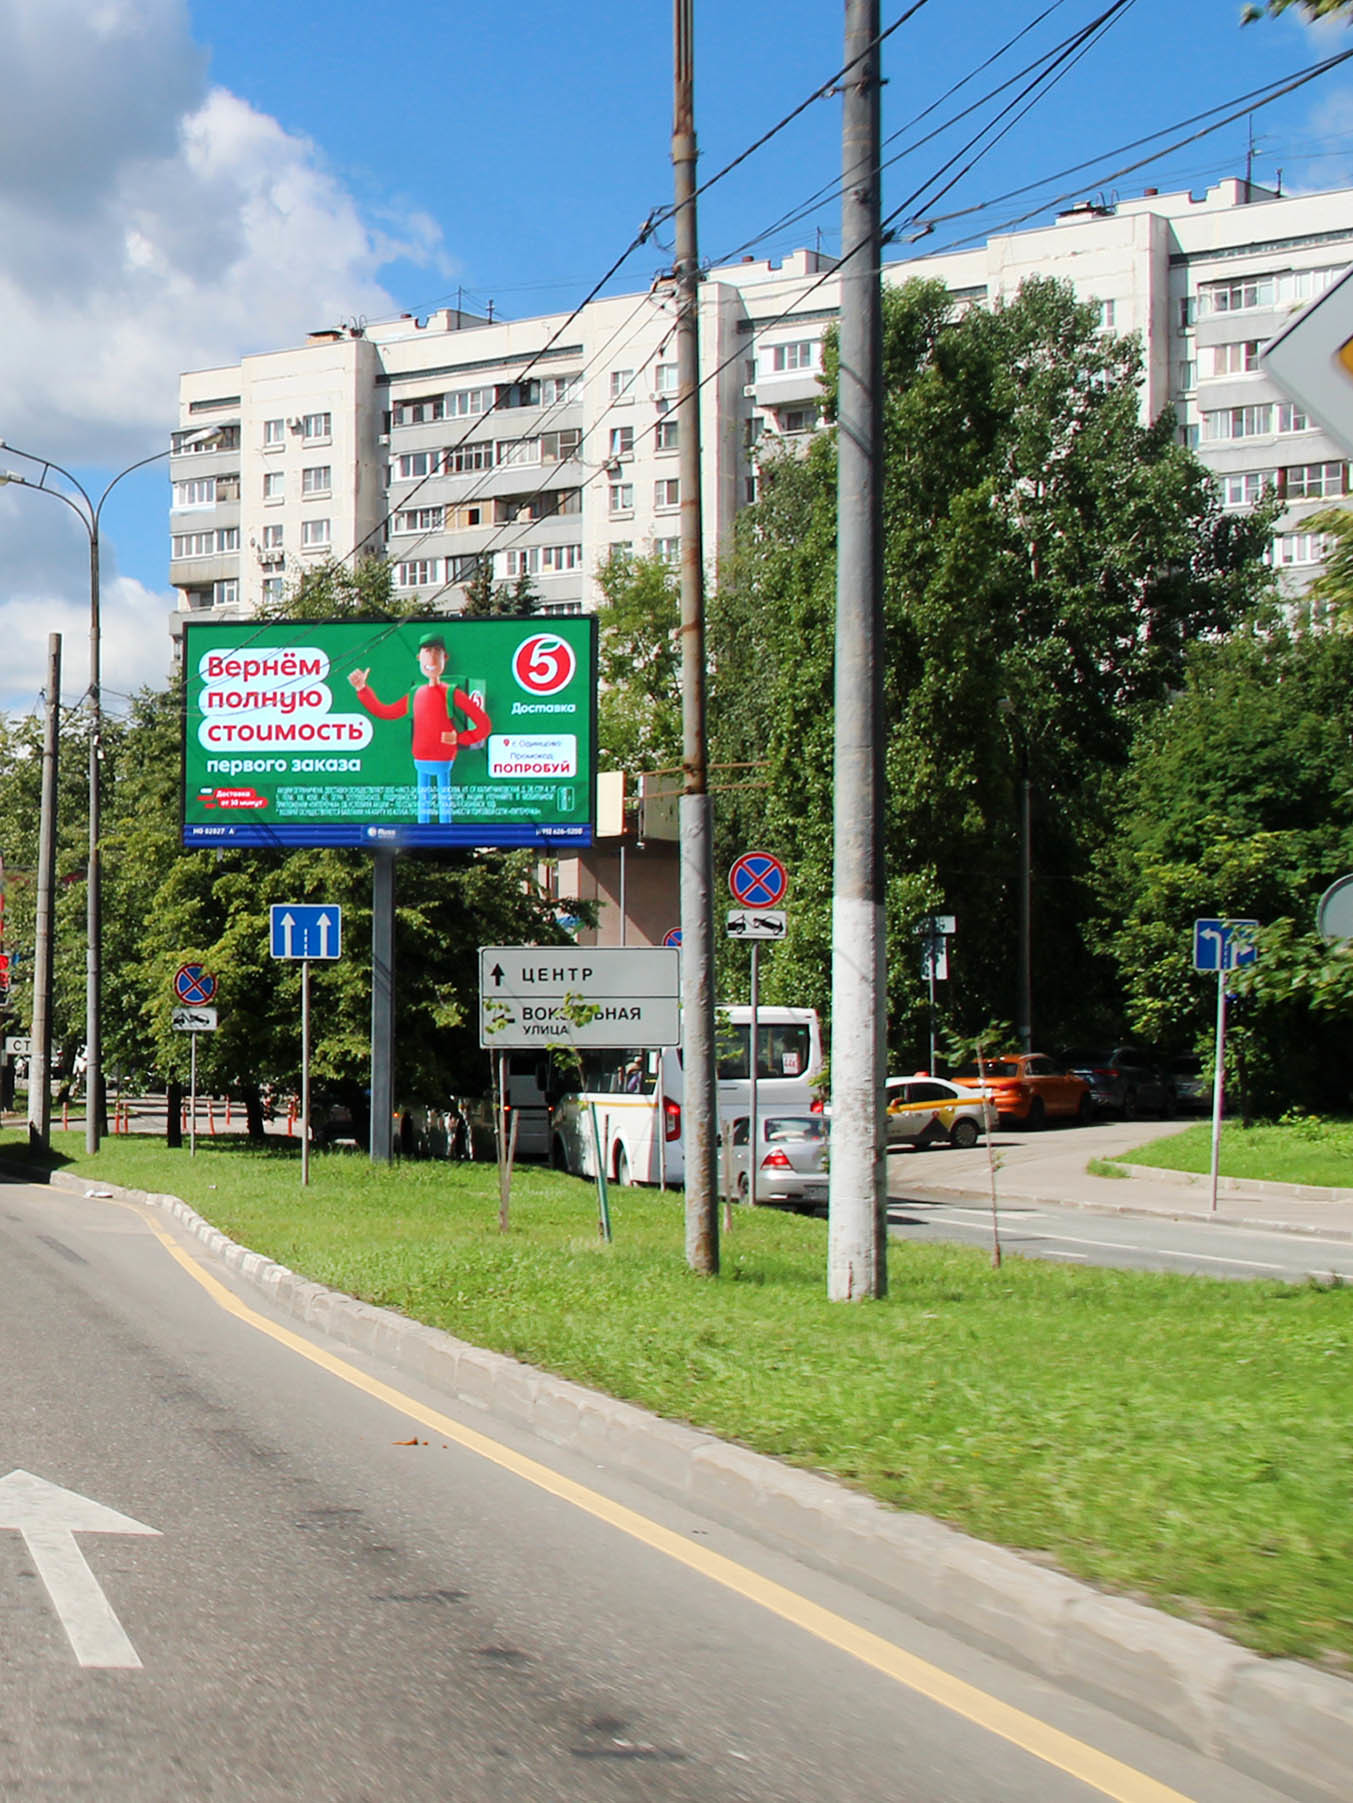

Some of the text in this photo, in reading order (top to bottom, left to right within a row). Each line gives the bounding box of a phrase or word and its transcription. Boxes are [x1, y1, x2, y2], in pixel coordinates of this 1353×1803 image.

[208, 653, 321, 682] Вернём
[208, 690, 323, 714] полную
[511, 702, 576, 715] Доставка
[207, 759, 361, 776] первого заказа
[494, 761, 570, 773] ПОПРОБУЙ
[522, 968, 593, 983] ЦЕНТР
[522, 1007, 641, 1021] ВОКЬНАЯ
[522, 1025, 569, 1035] УЛИЦА
[13, 1039, 31, 1051] СТ
